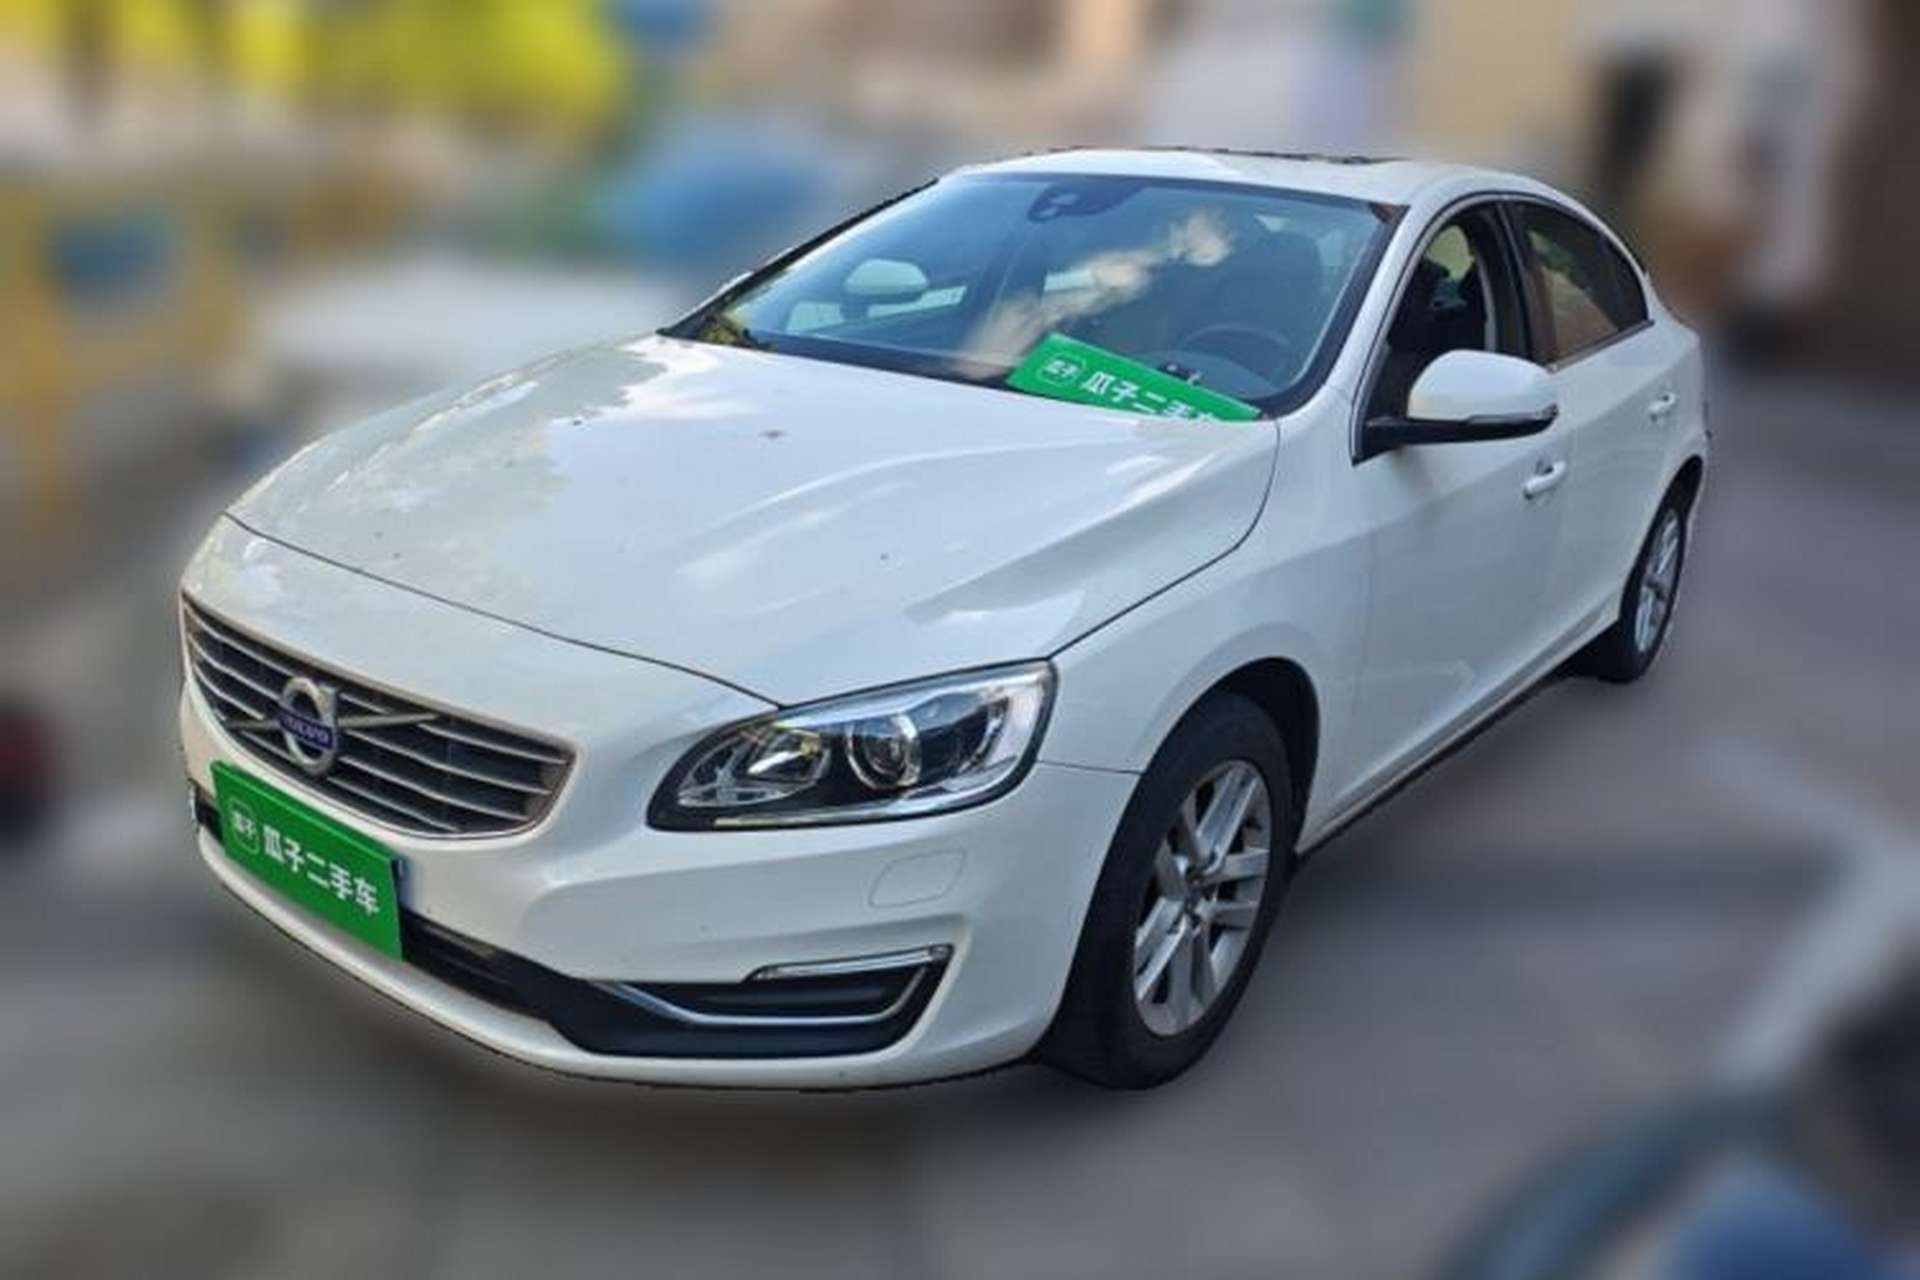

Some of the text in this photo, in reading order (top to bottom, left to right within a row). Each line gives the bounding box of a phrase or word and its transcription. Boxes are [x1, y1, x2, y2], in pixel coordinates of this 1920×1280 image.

[262, 824, 380, 916] 瓜子二手车
